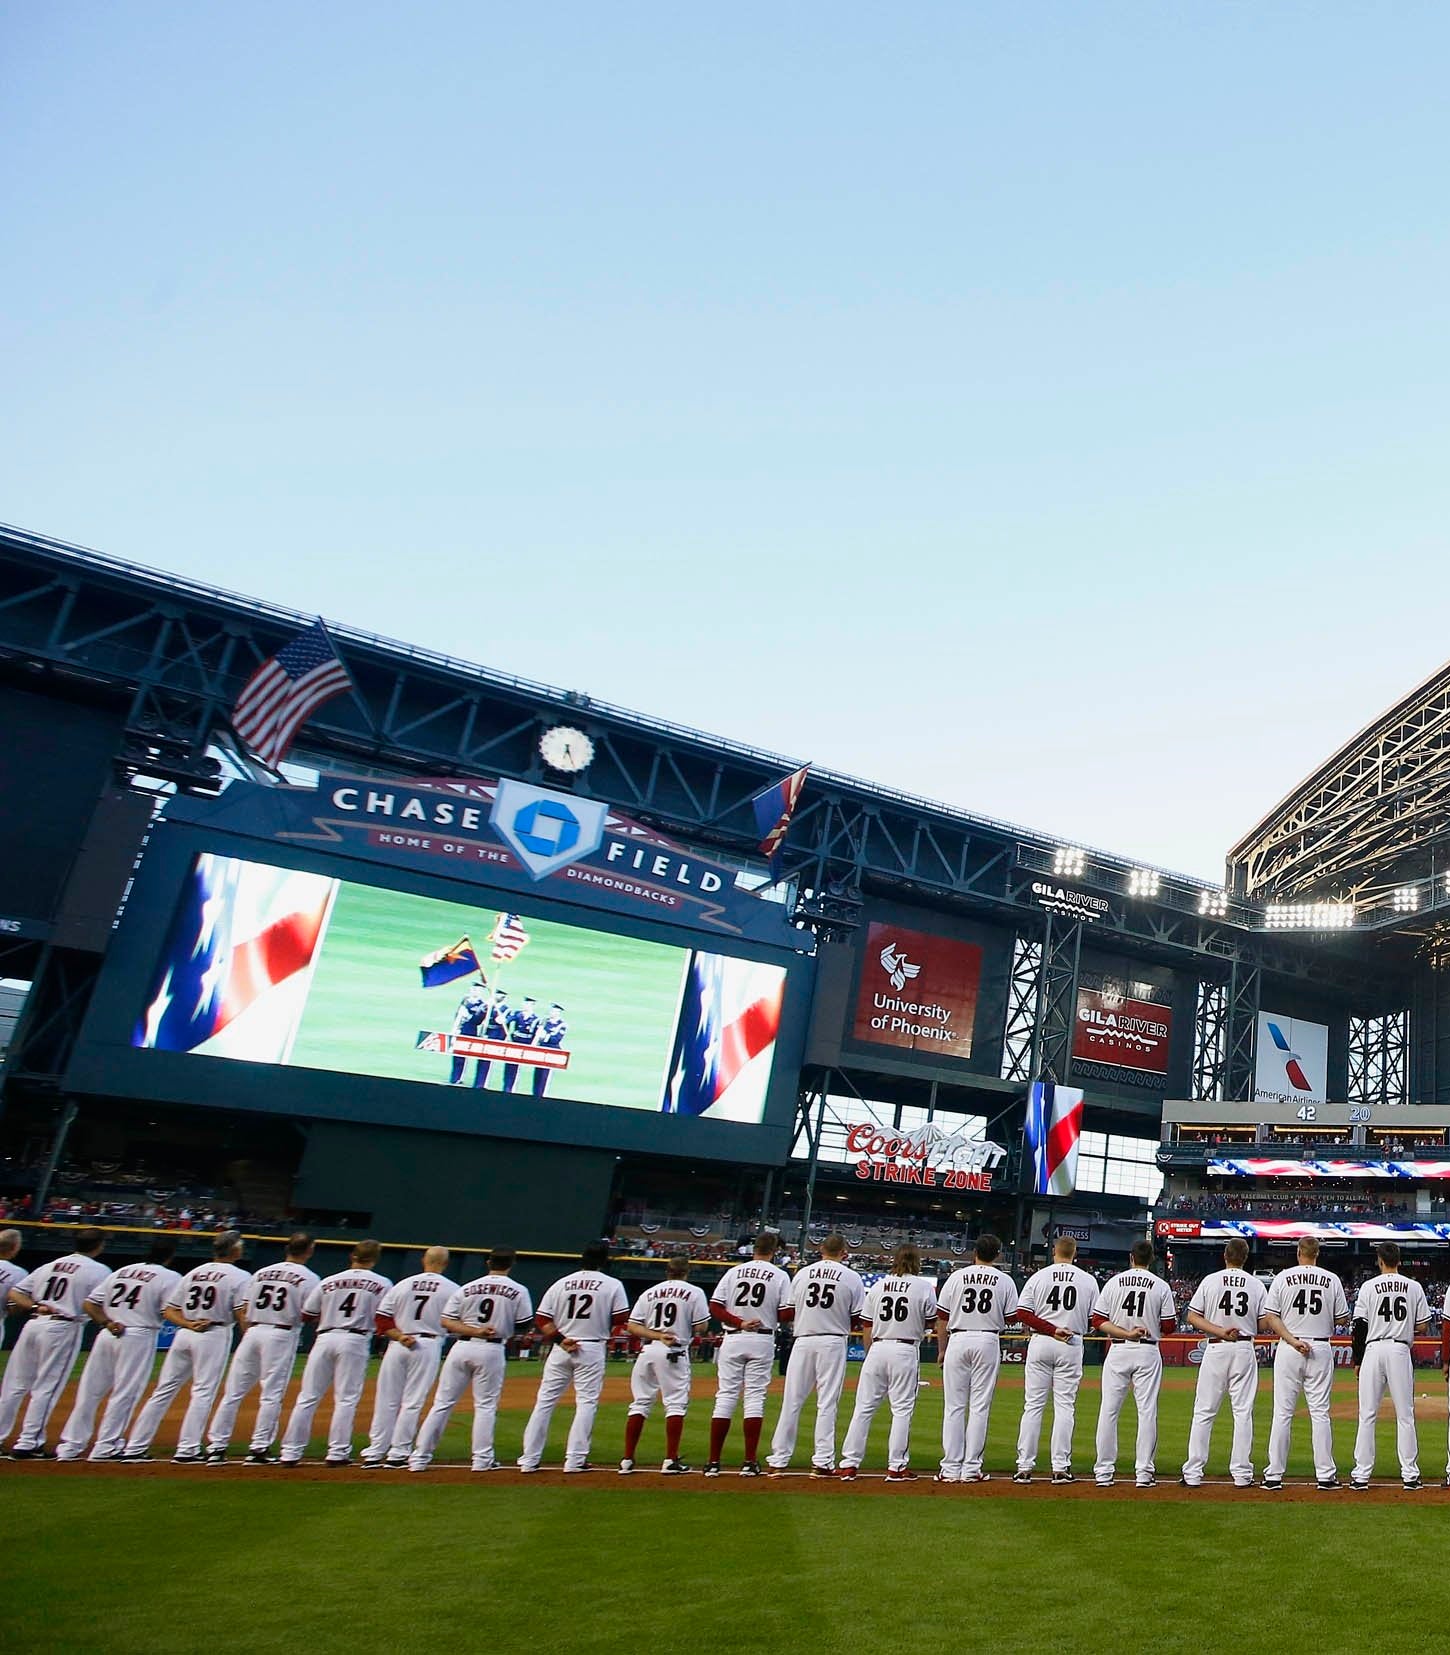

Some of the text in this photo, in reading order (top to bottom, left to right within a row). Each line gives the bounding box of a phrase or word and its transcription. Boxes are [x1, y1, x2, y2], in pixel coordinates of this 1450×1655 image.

[332, 788, 723, 894] CHASE FIELD
[379, 832, 510, 864] HOME OF THE
[567, 868, 677, 906] DIAMONDBACKS
[1032, 882, 1108, 912] GILA RIVER
[1045, 906, 1093, 922] CASINOS
[874, 993, 951, 1024] University
[871, 1015, 952, 1041] of Phoenix
[1078, 1008, 1167, 1037] GILA RIVER
[1089, 1035, 1151, 1052] CASINOS
[1255, 1088, 1292, 1103] American
[1297, 1106, 1371, 1122] 42 20
[847, 1123, 1007, 1168] Coors LIGHT
[856, 1160, 993, 1191] STRIKE ZONE
[321, 1279, 385, 1295] PENNINGTON
[411, 1281, 440, 1292] ROSS
[564, 1279, 603, 1291] CHAVEZ
[736, 1269, 775, 1282] ZIEGLER
[809, 1268, 844, 1281] CAHILL
[883, 1281, 912, 1293] MILEY
[962, 1274, 1000, 1287] HARRIS
[1052, 1271, 1076, 1283] PUTZ
[1119, 1276, 1156, 1290] HUDSON
[1222, 1275, 1247, 1288] REED
[1286, 1273, 1332, 1289] REYNOLDS
[42, 1276, 69, 1301] 10
[109, 1283, 143, 1309] 24
[186, 1286, 216, 1310] 39
[255, 1285, 288, 1311] 53
[464, 1284, 520, 1300] GOSEWISCH
[647, 1287, 692, 1301] CAMPANA
[734, 1281, 766, 1308] 29
[805, 1283, 836, 1309] 35
[1046, 1285, 1078, 1311] 40
[1374, 1281, 1409, 1294] CORBIN
[339, 1292, 357, 1317] 4
[413, 1295, 430, 1320] 7
[477, 1298, 495, 1323] 9
[566, 1294, 593, 1319] 12
[879, 1296, 909, 1322] 36
[961, 1288, 994, 1314] 38
[1121, 1290, 1147, 1317] 41
[1218, 1290, 1249, 1317] 43
[1292, 1288, 1323, 1315] 45
[1377, 1296, 1408, 1322] 46
[653, 1302, 678, 1328] 19
